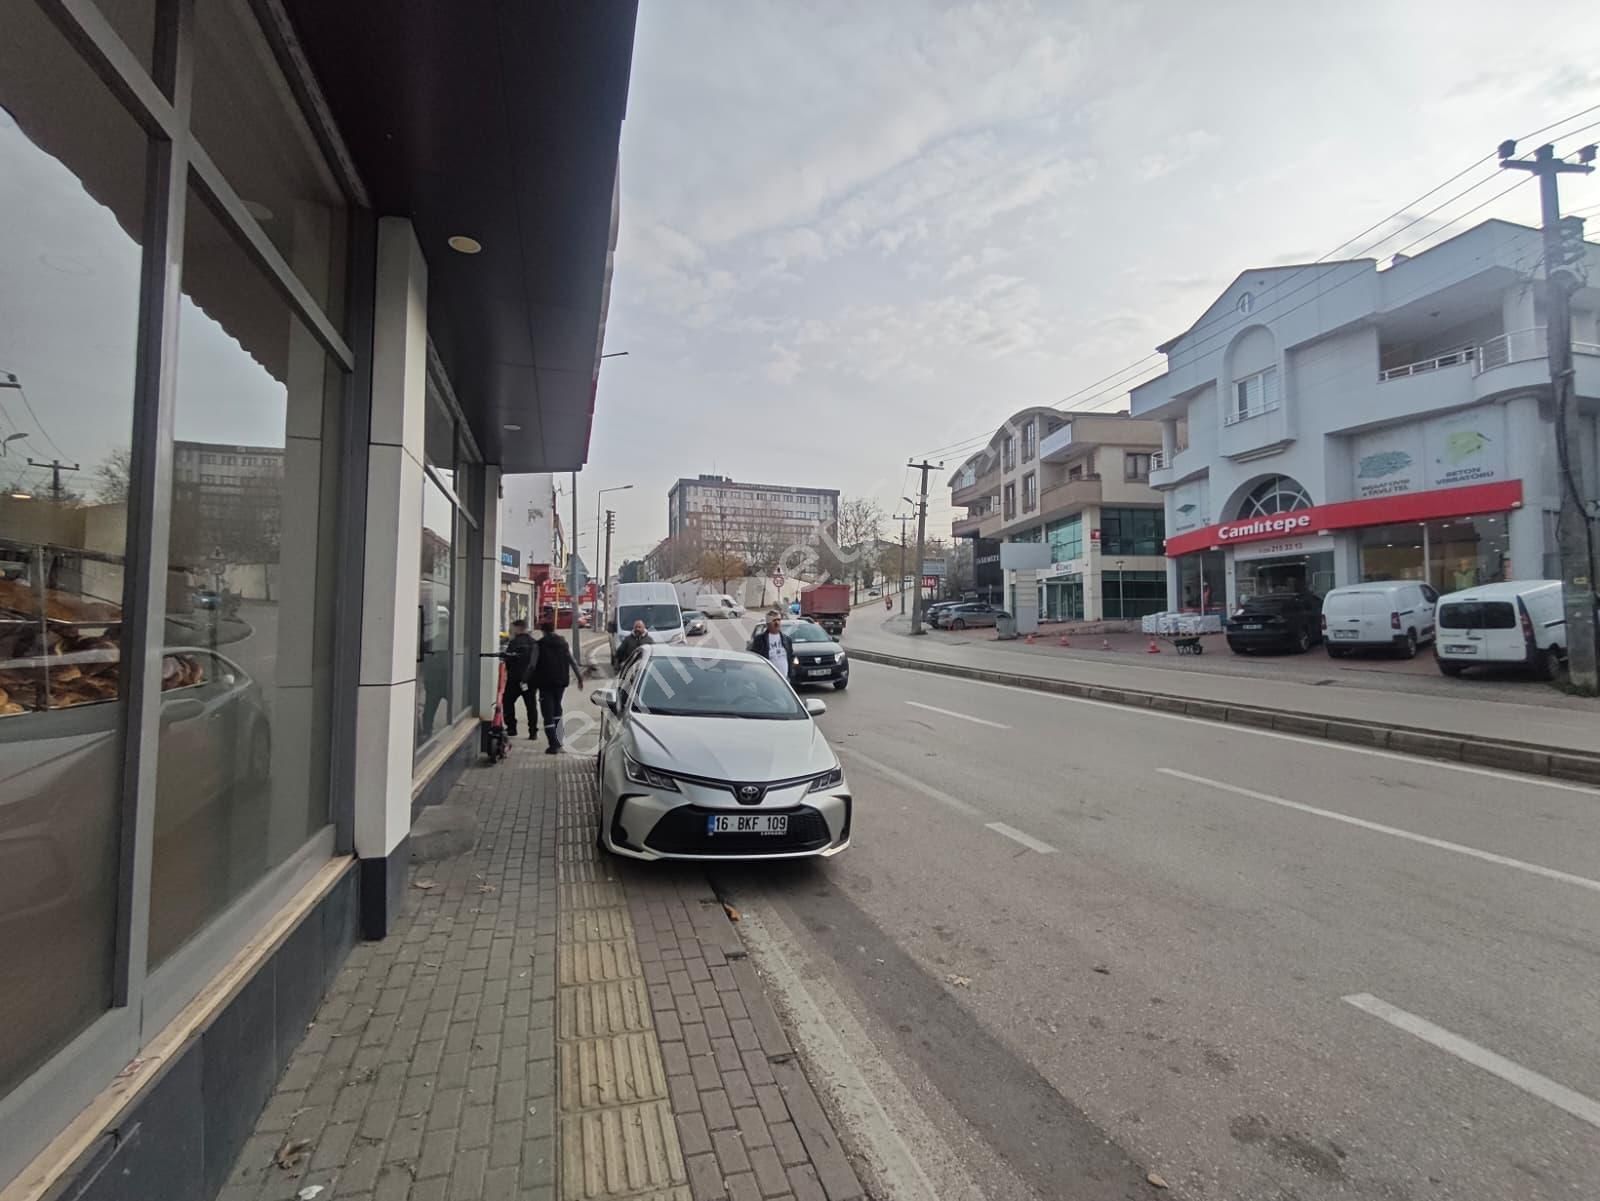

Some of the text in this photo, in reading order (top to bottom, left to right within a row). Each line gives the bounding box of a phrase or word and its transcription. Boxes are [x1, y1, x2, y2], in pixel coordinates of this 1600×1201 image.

[716, 817, 786, 830] 16 BKF 109
